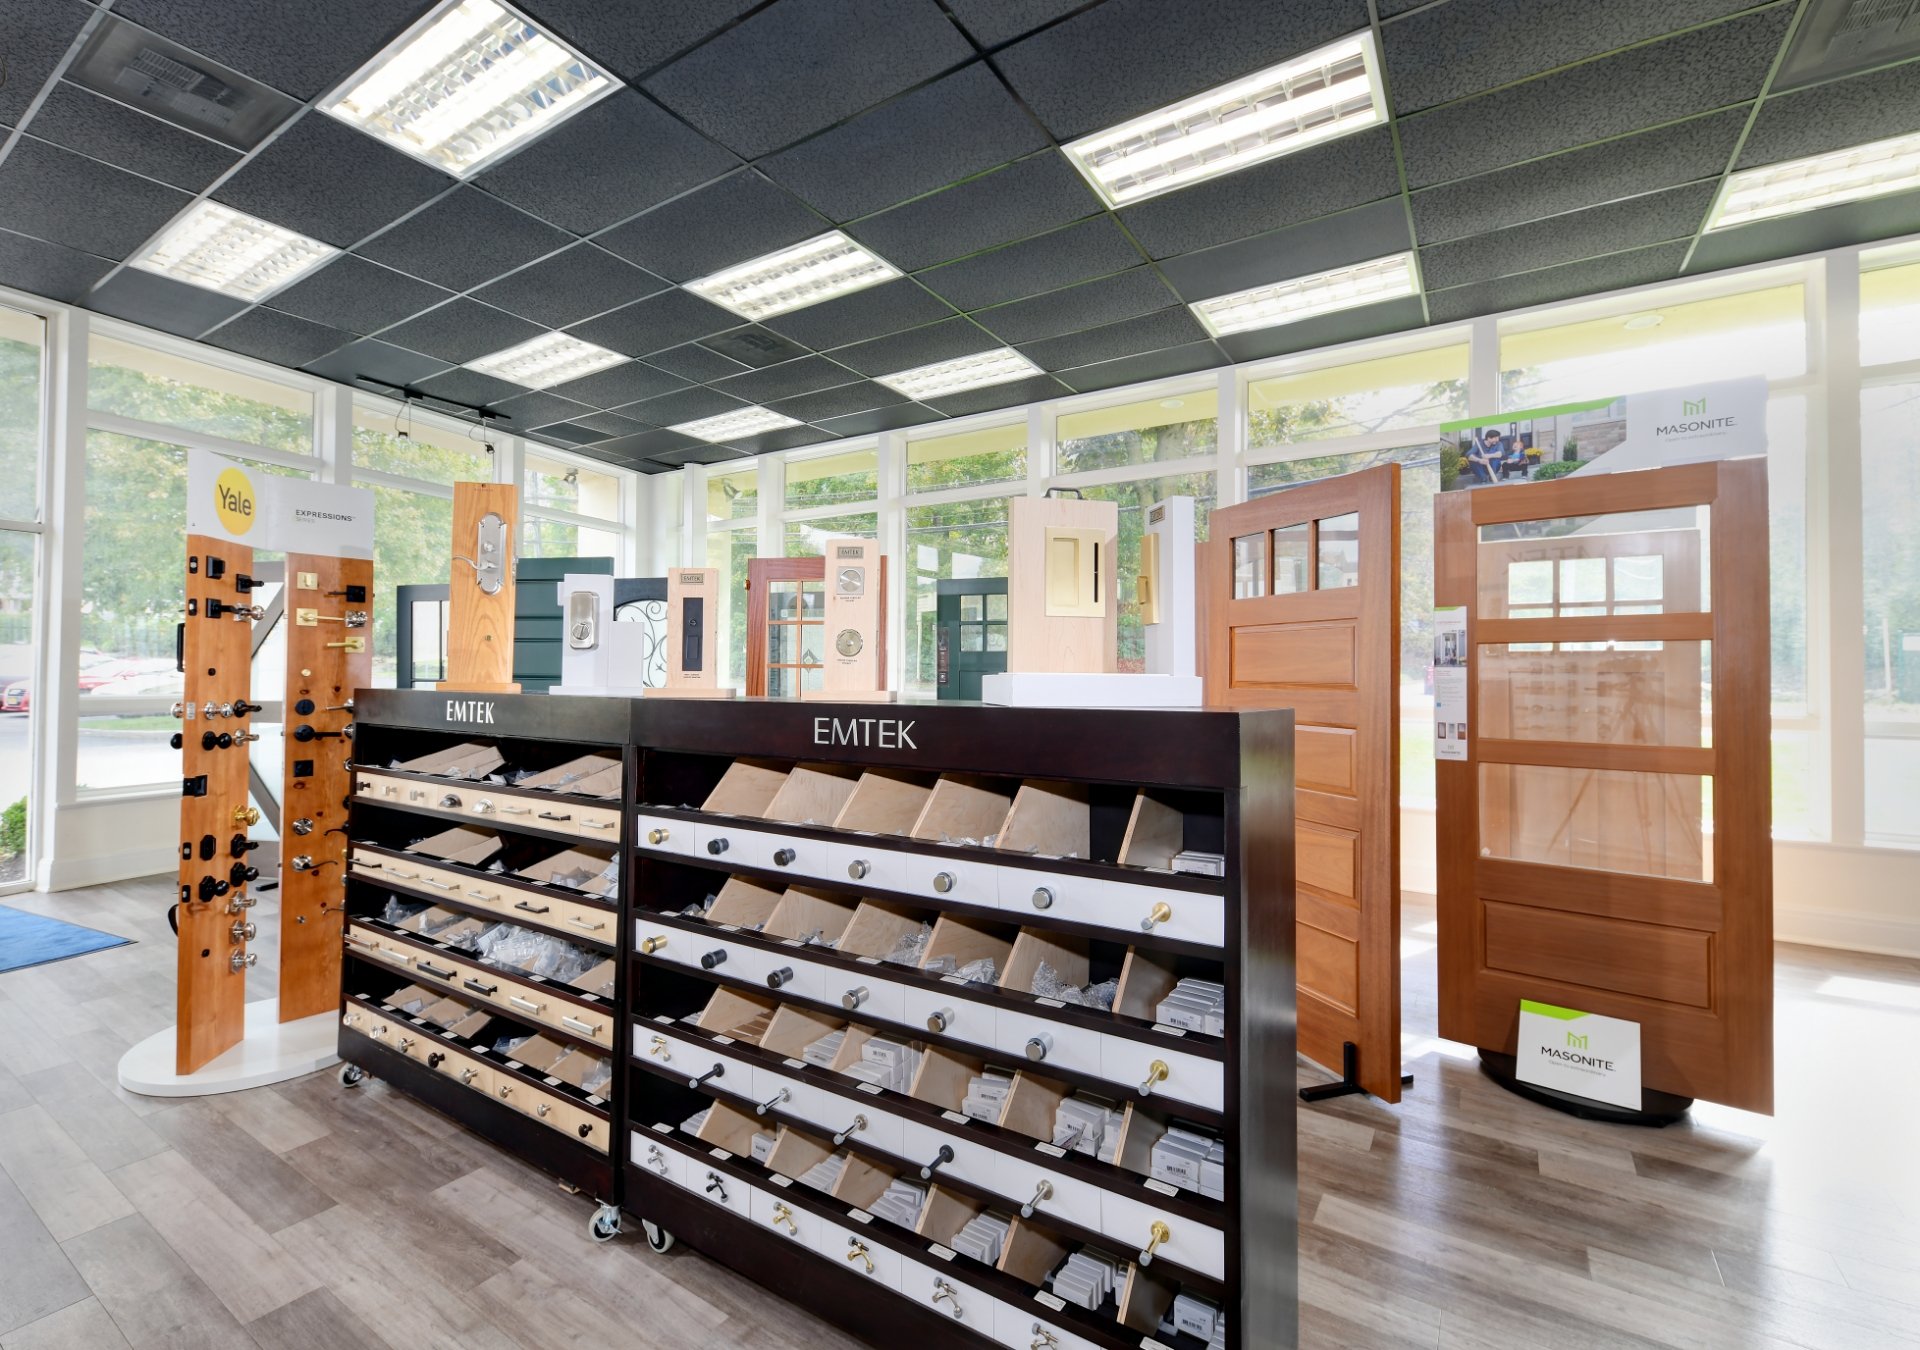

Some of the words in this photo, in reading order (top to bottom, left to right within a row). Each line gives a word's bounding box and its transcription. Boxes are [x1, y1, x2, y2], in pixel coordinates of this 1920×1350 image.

[1656, 416, 1737, 436] MASONITE
[218, 484, 252, 516] Yale
[295, 509, 353, 522] EXPRESSIONS
[446, 700, 495, 724] EMTEK
[814, 717, 918, 750] EMTEK
[1541, 1046, 1615, 1072] MASONITE
